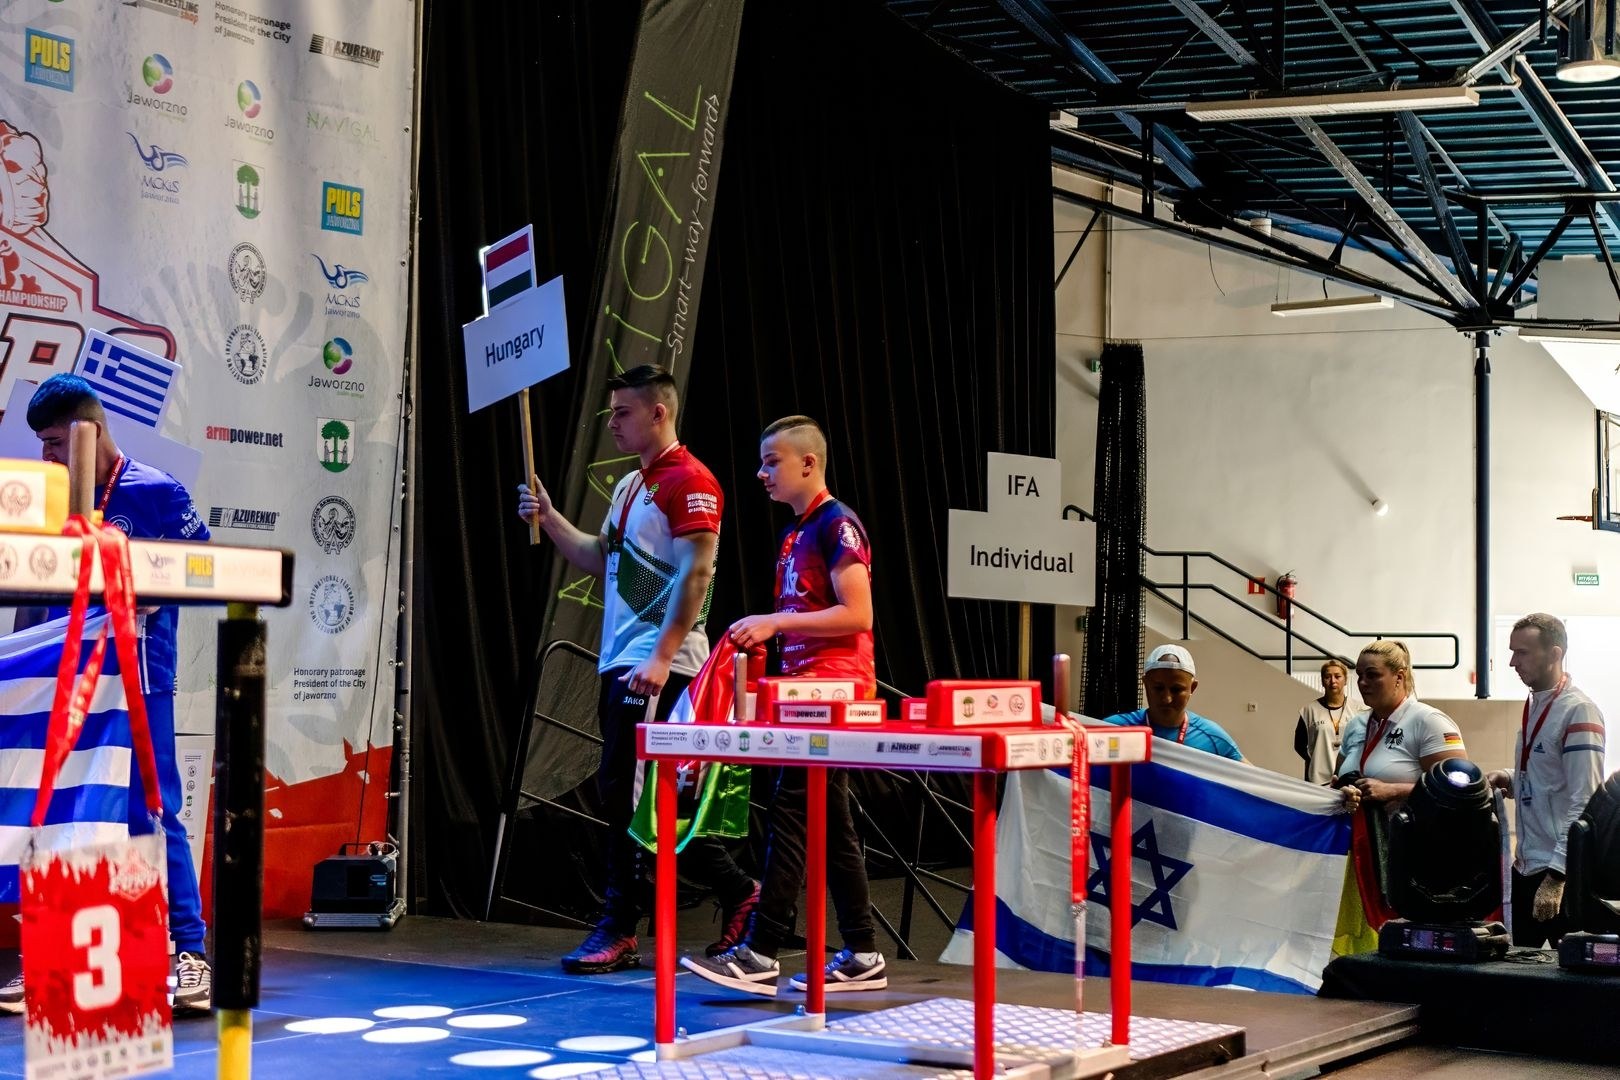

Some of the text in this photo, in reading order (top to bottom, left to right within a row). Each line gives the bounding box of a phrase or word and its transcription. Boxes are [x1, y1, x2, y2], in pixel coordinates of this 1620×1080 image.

[215, 2, 291, 30] Honorary patronage
[215, 13, 291, 43] President of the City
[214, 25, 222, 34] of
[30, 34, 71, 72] PULS
[127, 89, 188, 116] Jaworzno
[224, 115, 274, 140] Jaworzno
[306, 111, 380, 142] NAVIGAL
[326, 187, 361, 218] PULS
[485, 324, 545, 368] Hungary
[308, 376, 365, 392] Jaworzno
[206, 425, 284, 448] armpower.net
[1008, 474, 1040, 497] IFA
[970, 545, 1074, 573] Individual
[293, 667, 366, 678] Honorary patronage
[293, 679, 367, 690] President of the City
[293, 691, 337, 701] of Jaworzno
[623, 696, 645, 706] JAKO
[71, 904, 123, 1012] 3
